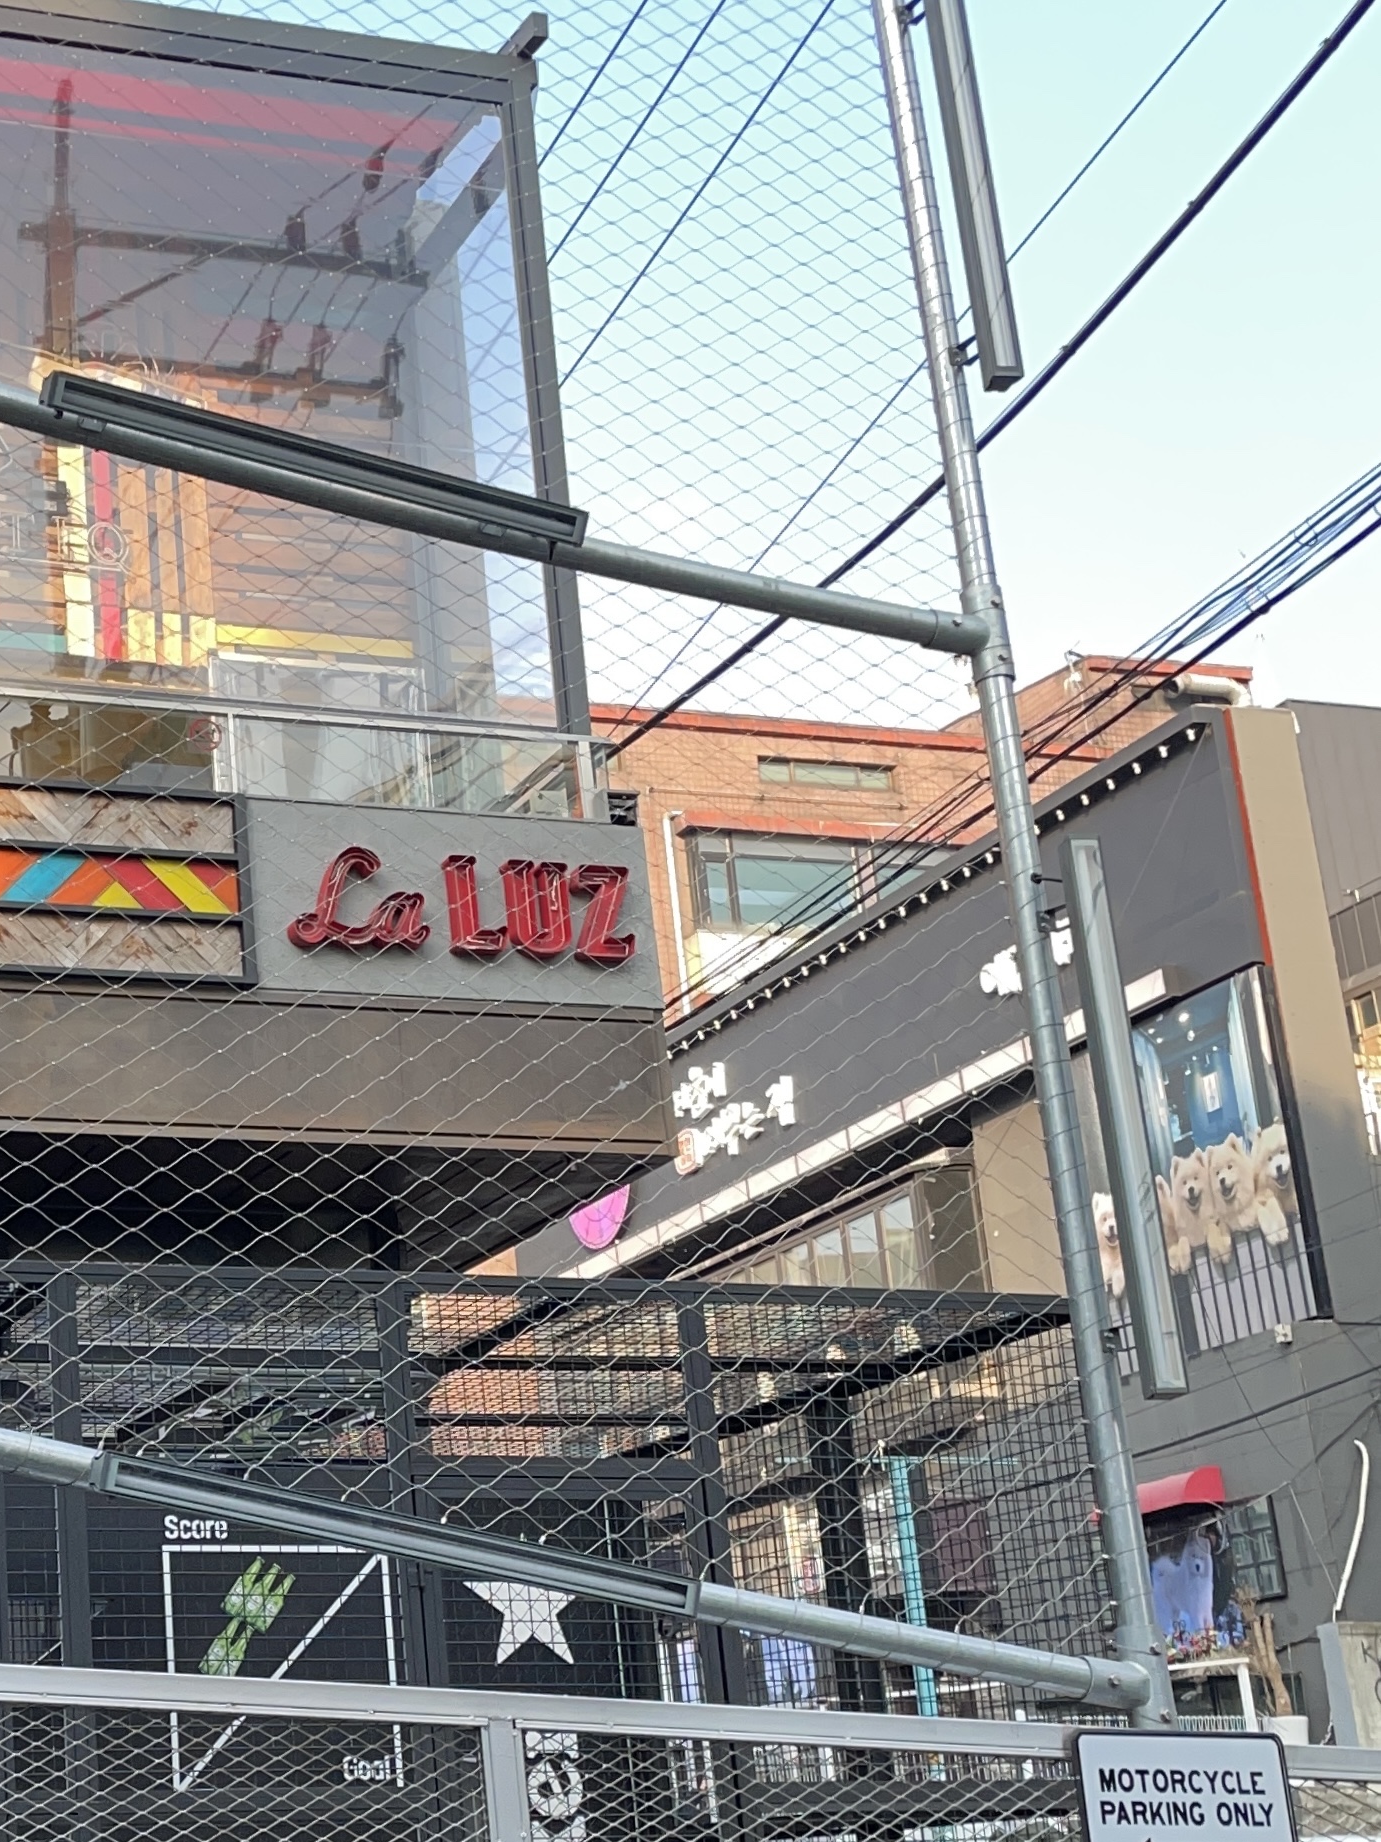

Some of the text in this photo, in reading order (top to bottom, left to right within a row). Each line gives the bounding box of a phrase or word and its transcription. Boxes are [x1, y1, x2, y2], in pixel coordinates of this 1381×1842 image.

[287, 846, 637, 965] La LUZ
[164, 1515, 229, 1540] Score
[343, 1756, 391, 1780] Goal
[1099, 1768, 1266, 1795] MOTORCYCLE
[1100, 1801, 1274, 1827] PARKING ONLY
